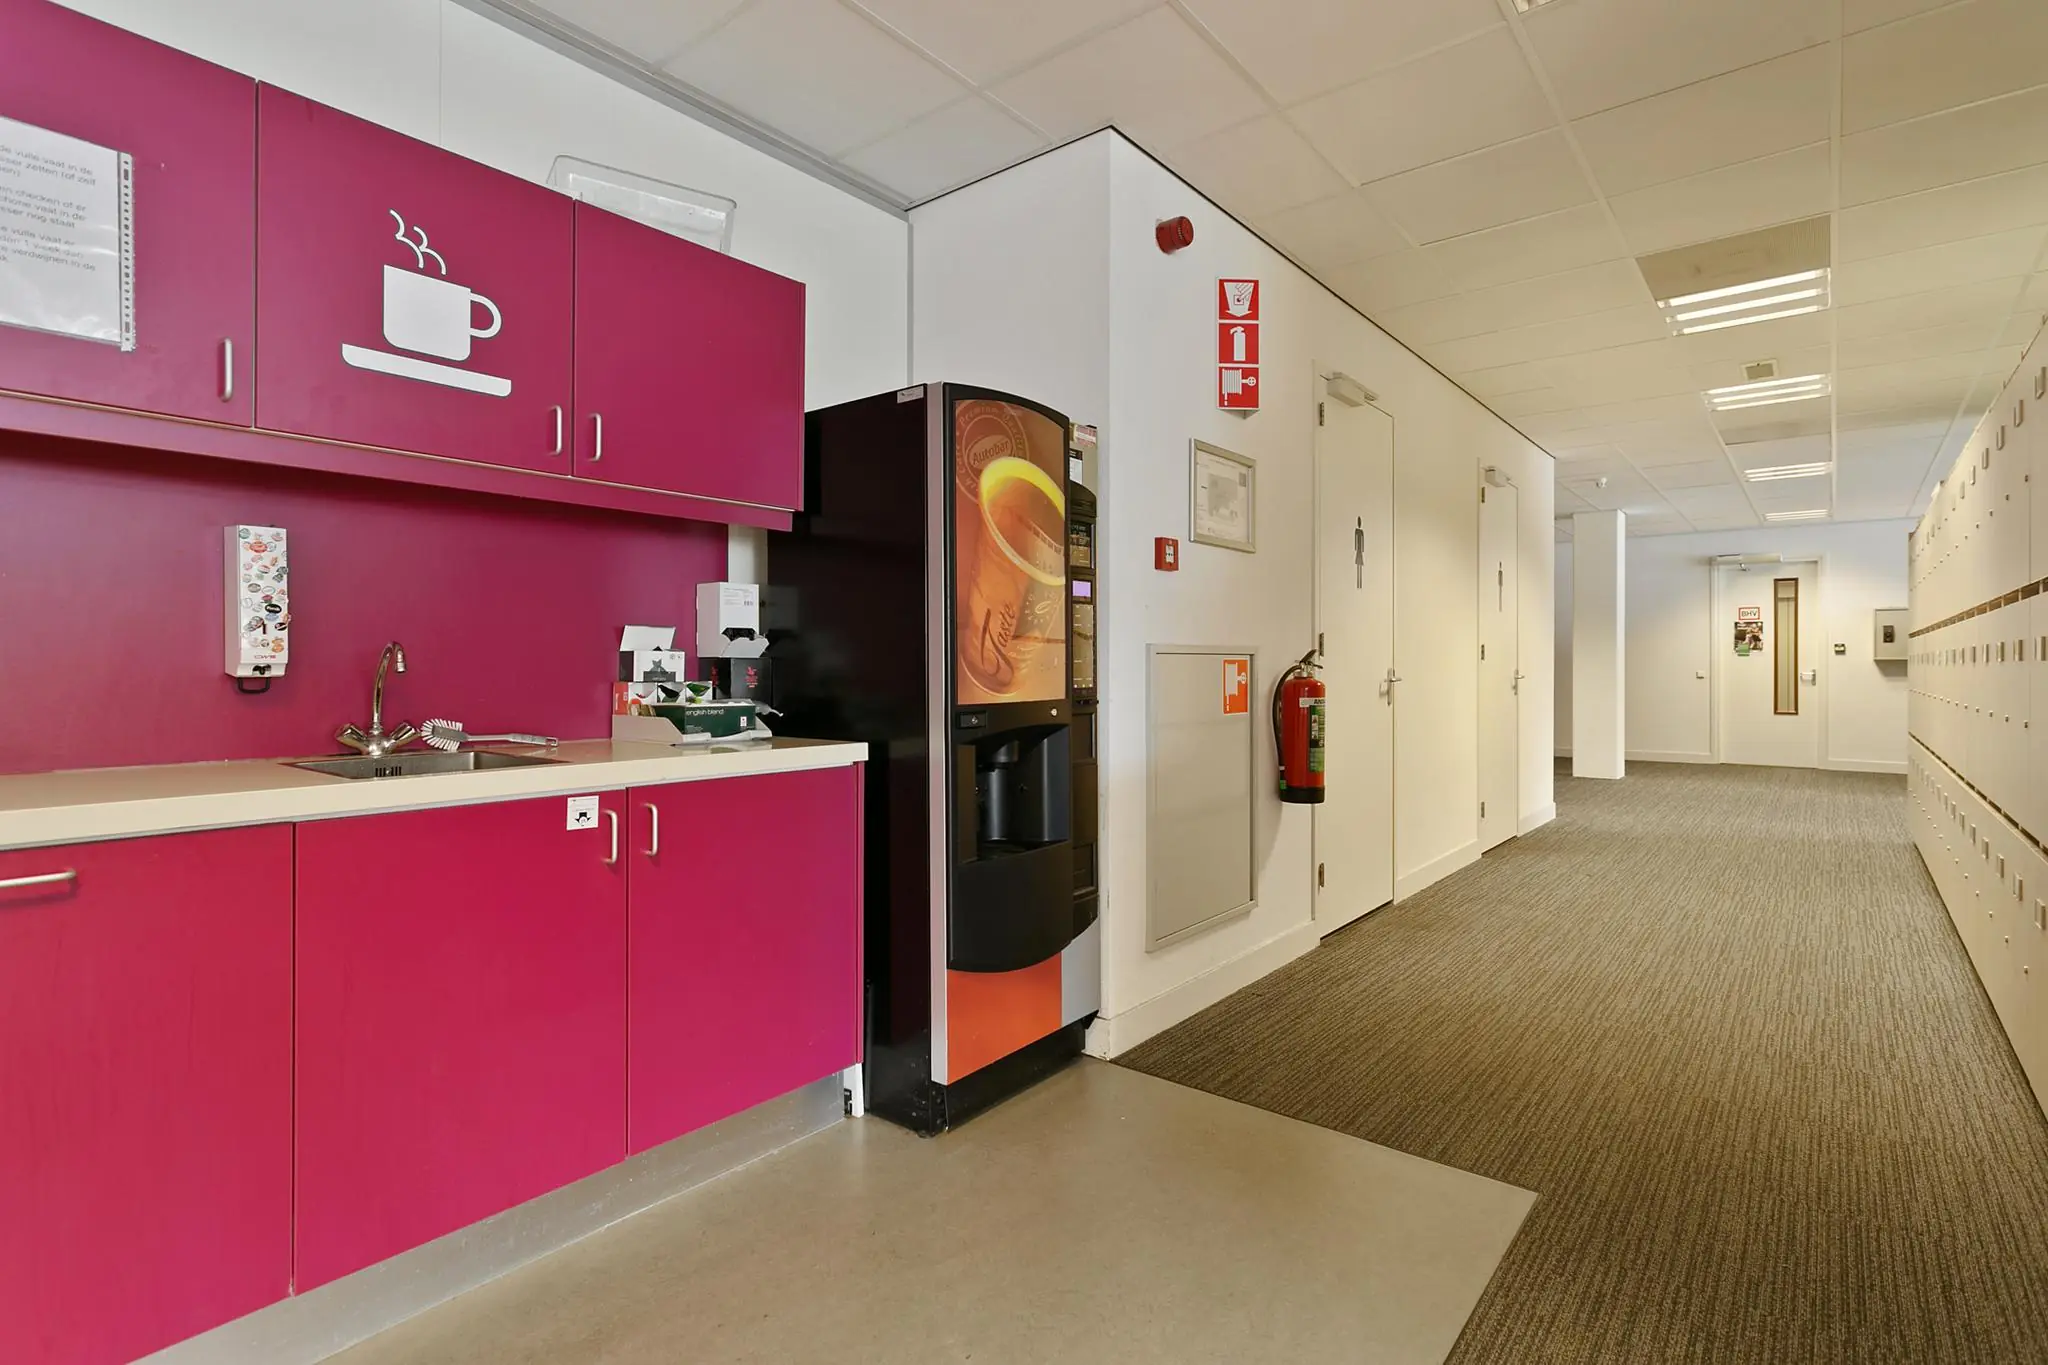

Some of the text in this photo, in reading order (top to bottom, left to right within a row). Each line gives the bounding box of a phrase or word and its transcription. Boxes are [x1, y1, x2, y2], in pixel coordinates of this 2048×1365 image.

[26, 163, 58, 178] zetten
[80, 167, 93, 176] de
[971, 439, 1011, 468] Autobar
[980, 602, 1016, 687] Taste
